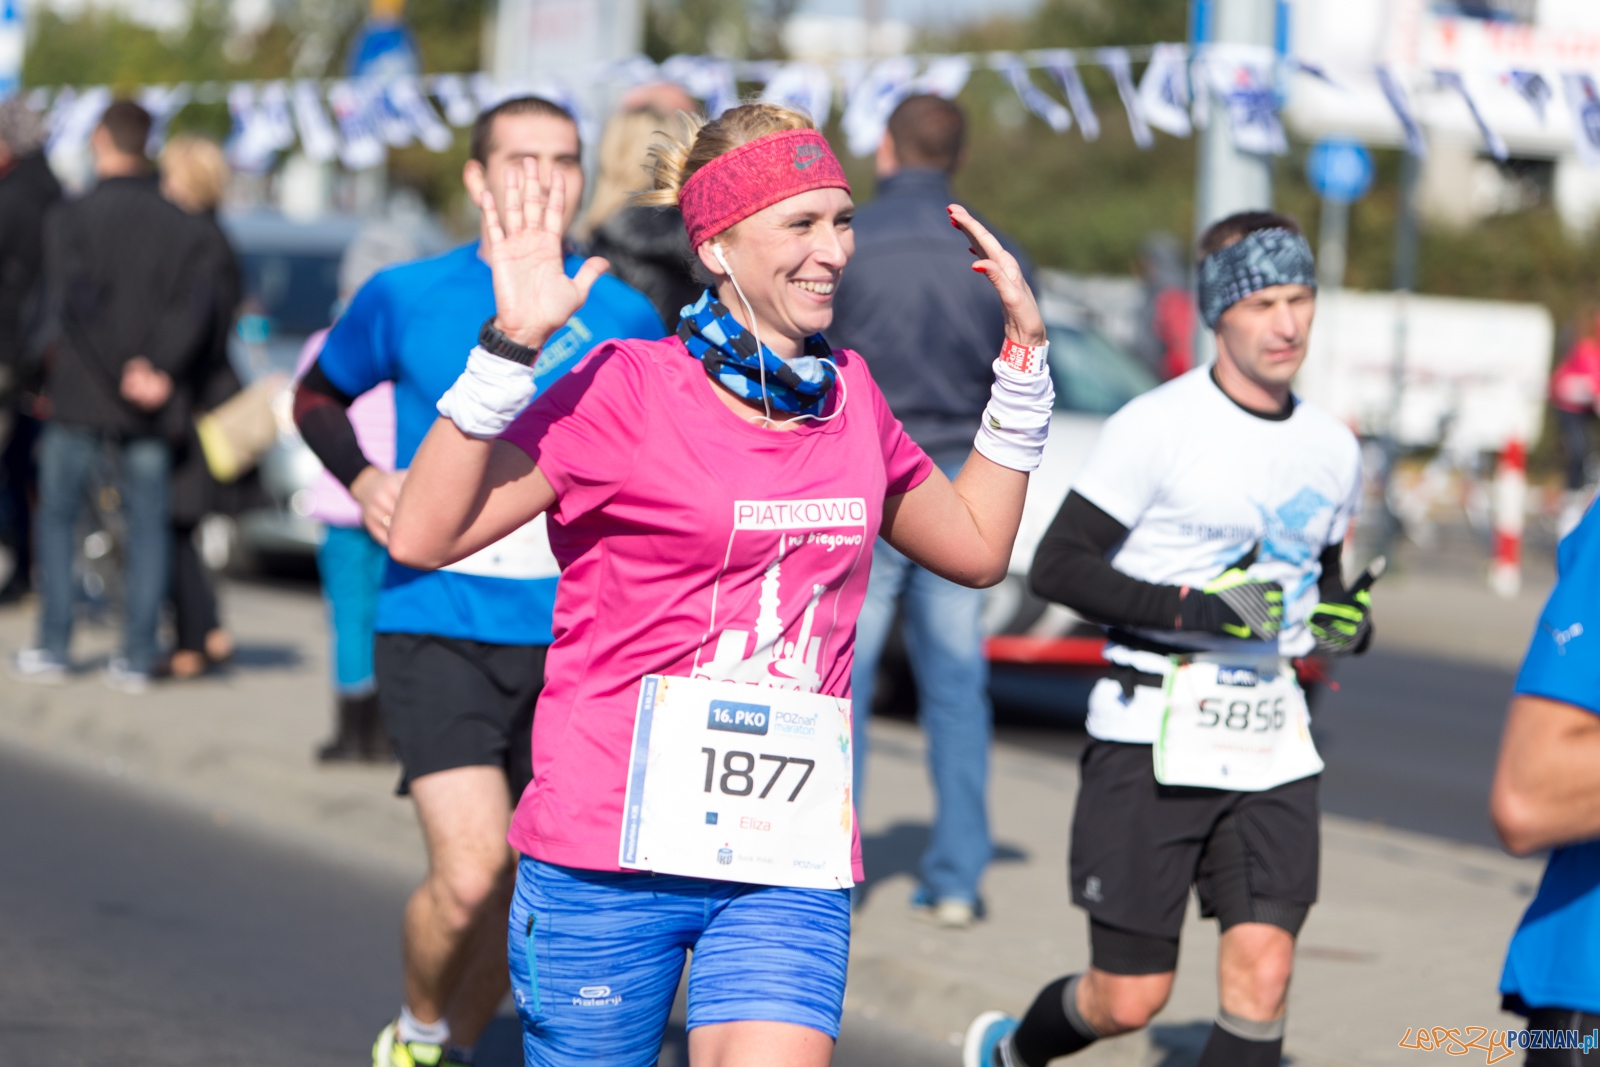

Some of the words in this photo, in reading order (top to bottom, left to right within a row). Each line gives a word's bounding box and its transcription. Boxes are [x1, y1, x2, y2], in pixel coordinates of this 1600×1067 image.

[1013, 347, 1026, 371] FINISH
[807, 531, 862, 552] biegowo
[713, 707, 734, 724] 16.
[734, 710, 766, 727] PKO
[1196, 697, 1286, 733] 5856
[773, 722, 816, 736] maraton
[701, 747, 816, 803] 1877
[739, 816, 772, 832] Eliza
[572, 995, 622, 1007] Kalenji
